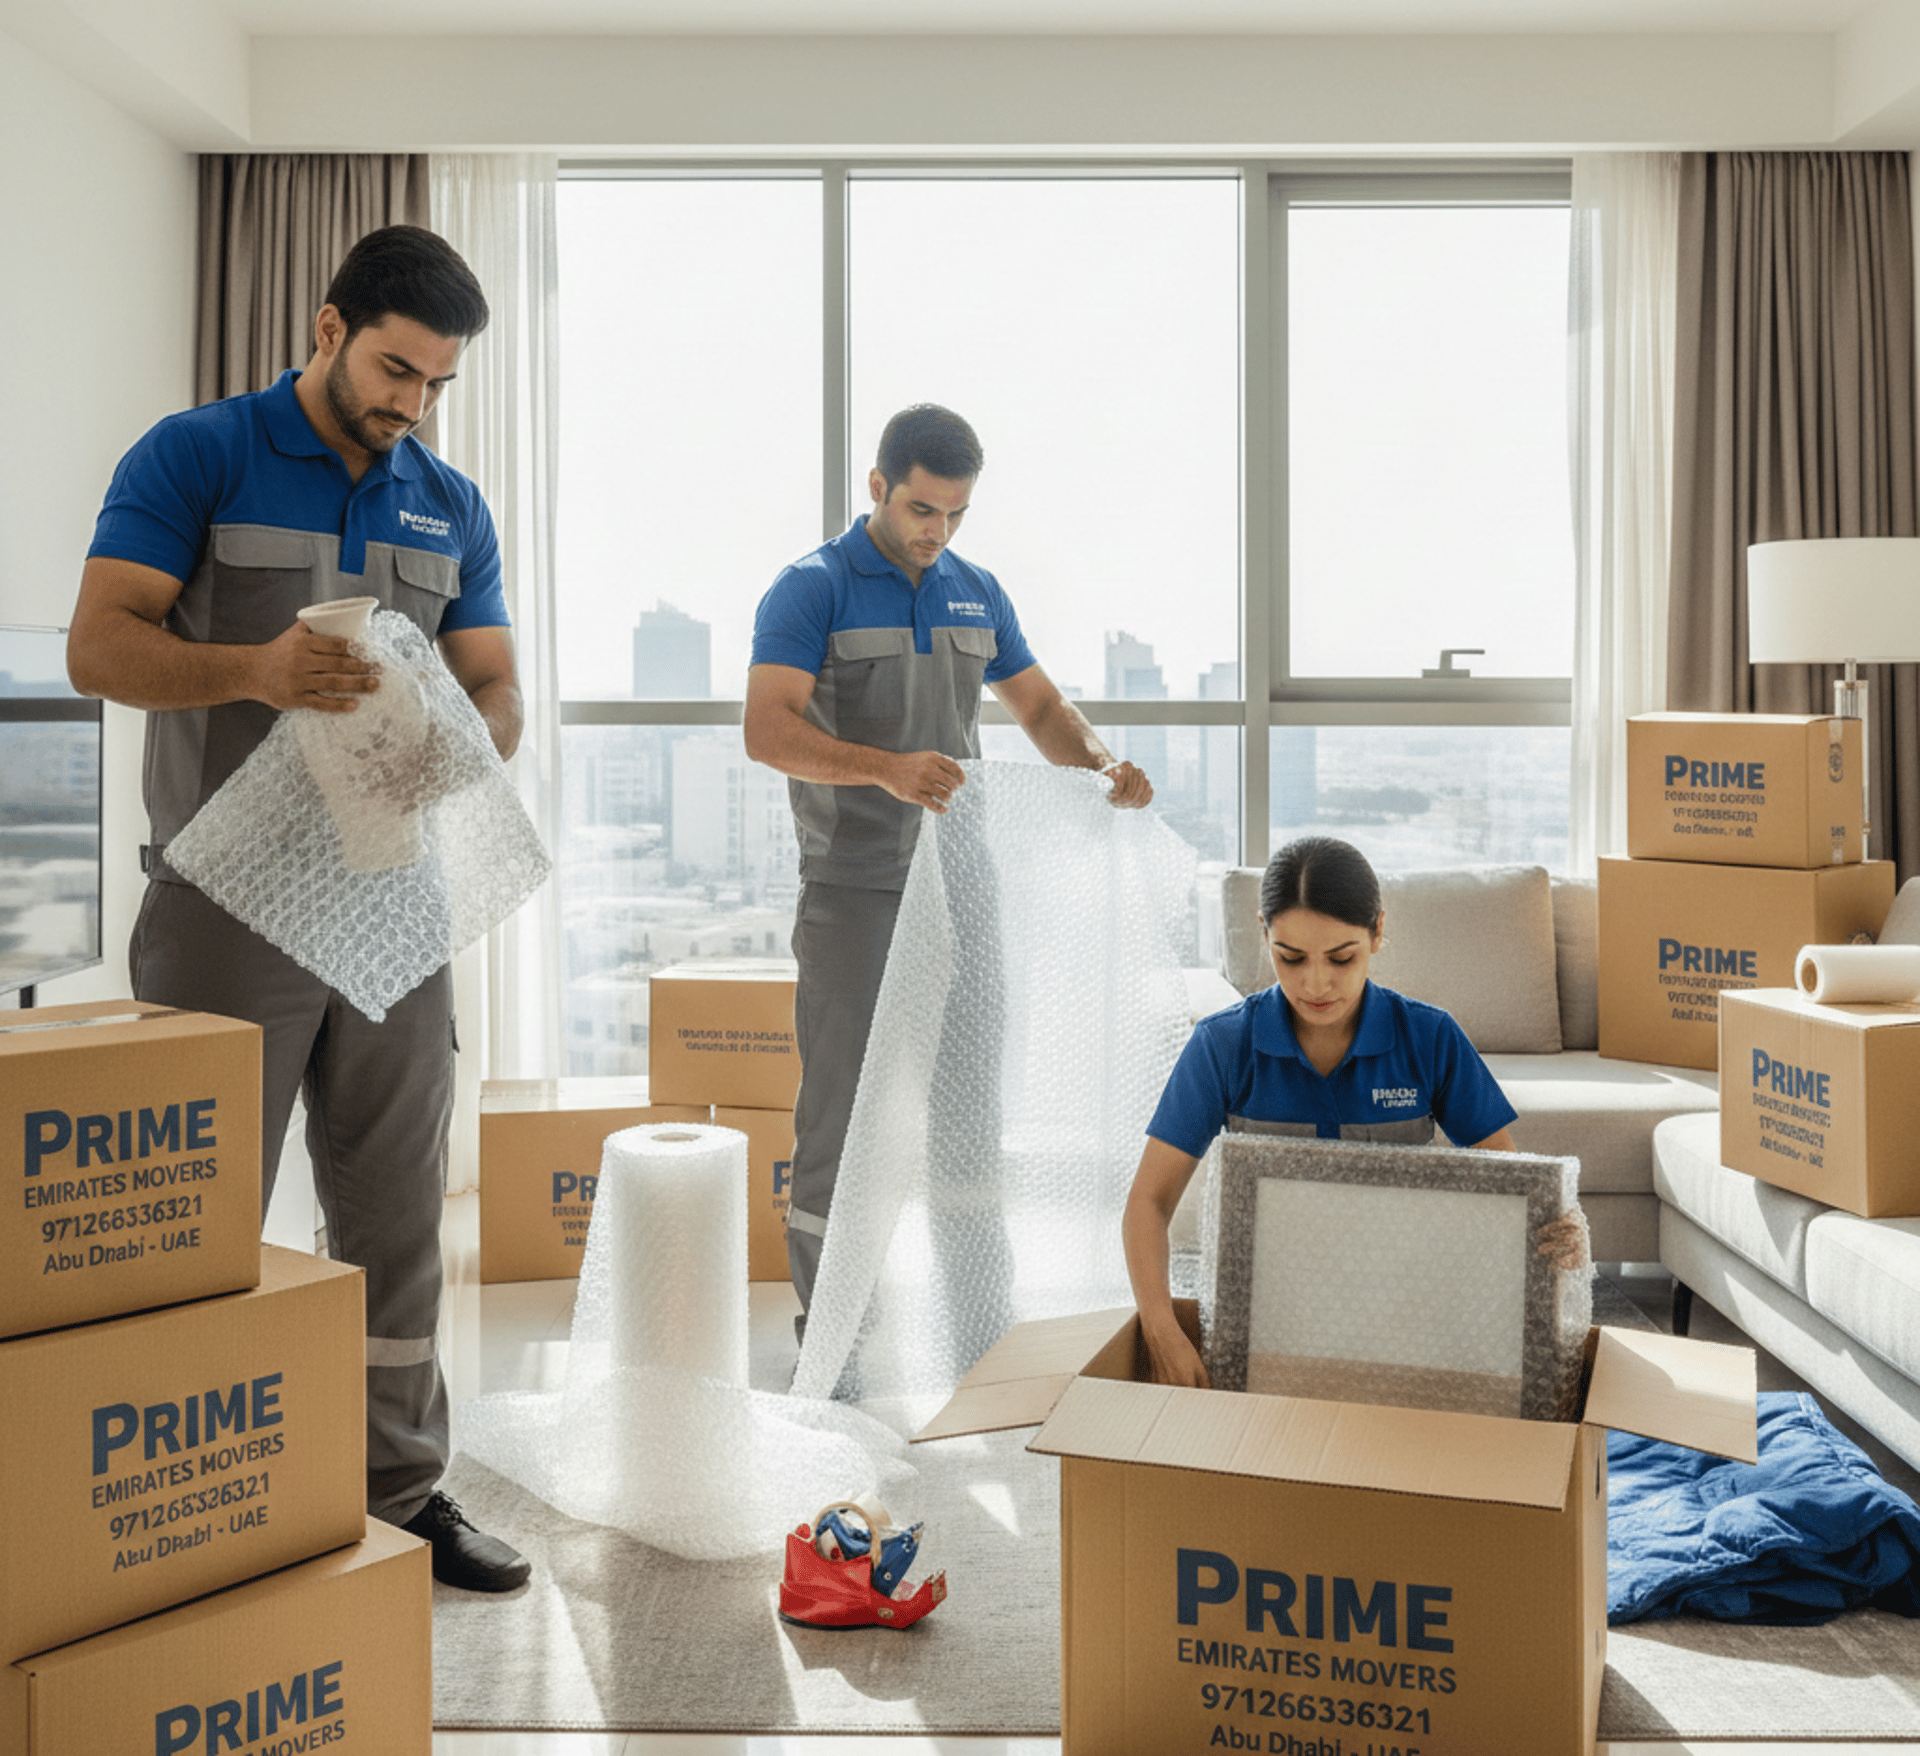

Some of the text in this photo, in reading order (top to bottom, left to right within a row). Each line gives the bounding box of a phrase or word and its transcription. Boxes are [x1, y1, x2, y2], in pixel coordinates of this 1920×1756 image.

[1665, 755, 1765, 789] PRIME
[1659, 938, 1757, 978] PRIME
[1752, 1048, 1831, 1108] PRIME
[24, 1098, 216, 1177] PRIME
[24, 1158, 217, 1209] EMIRATES MOVERS
[43, 1252, 84, 1275] Abu
[161, 1228, 201, 1252] UAE
[92, 1372, 284, 1477] PRIME
[92, 1433, 284, 1509] EMIRATES MOVERS
[230, 1505, 269, 1534] UAE
[1177, 1548, 1454, 1654] PRIME
[1177, 1637, 1457, 1694] EMIRATES MOVERS
[155, 1660, 344, 1756] PRIME
[1201, 1683, 1430, 1735] 971266336321
[1210, 1724, 1261, 1751] Abu
